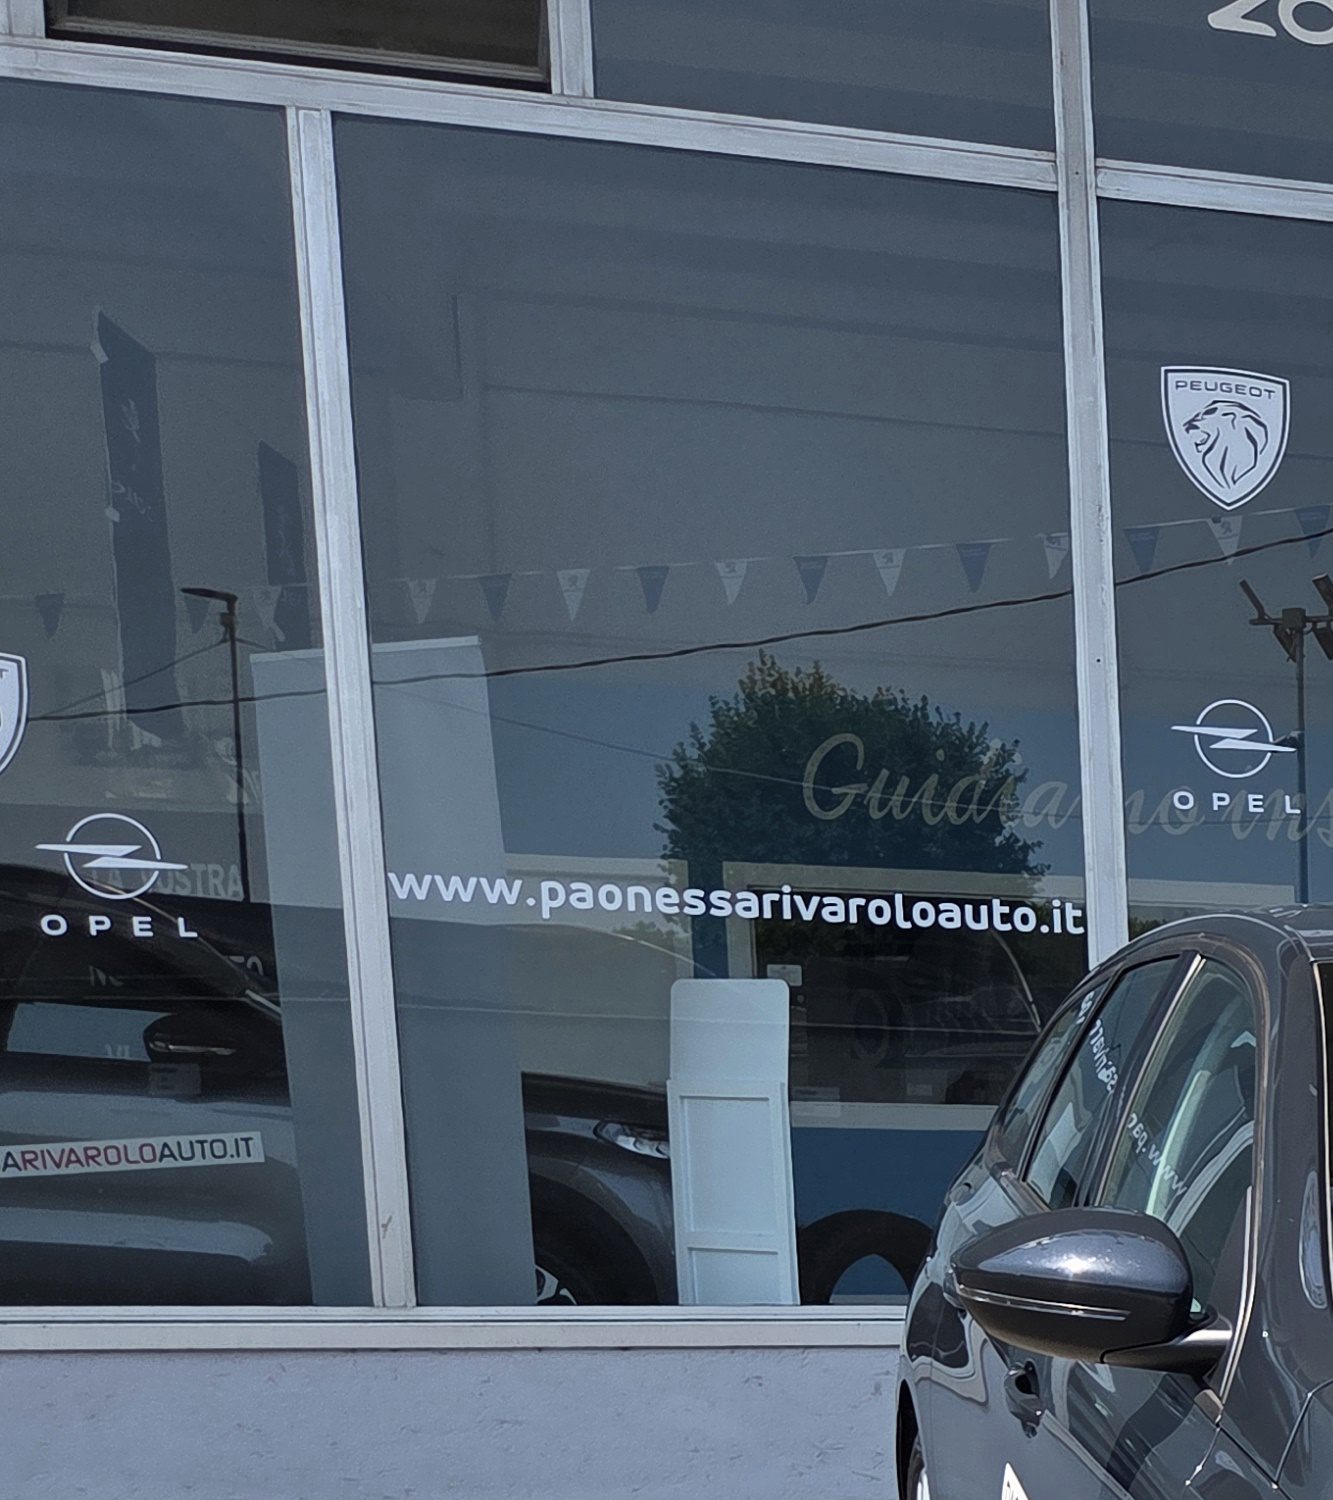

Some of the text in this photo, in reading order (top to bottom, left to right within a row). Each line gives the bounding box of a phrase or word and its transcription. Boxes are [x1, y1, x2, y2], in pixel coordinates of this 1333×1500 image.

[1175, 380, 1276, 399] PEUGEOT
[1172, 790, 1302, 815] OPEL
[388, 871, 1085, 936] www.paonessarivaroloauto.it
[40, 914, 198, 937] OPEL
